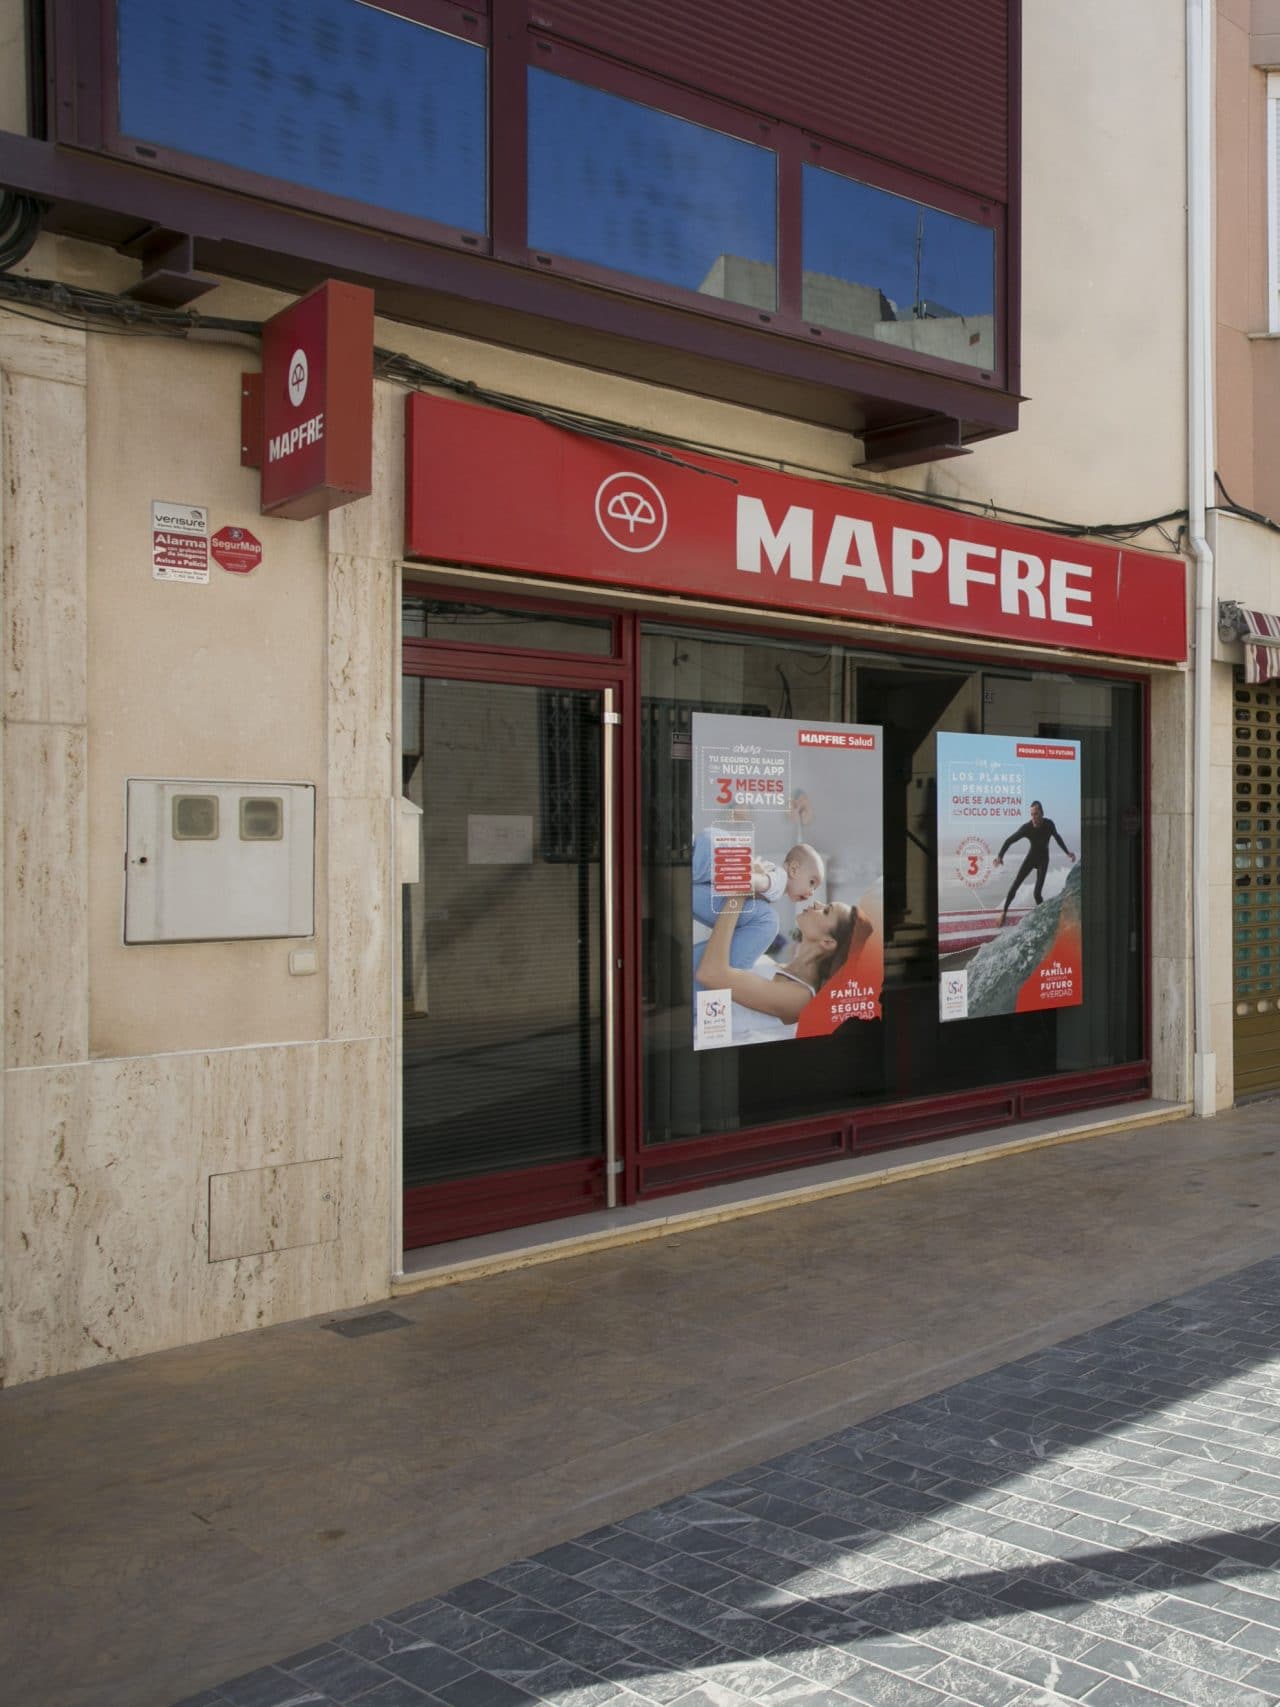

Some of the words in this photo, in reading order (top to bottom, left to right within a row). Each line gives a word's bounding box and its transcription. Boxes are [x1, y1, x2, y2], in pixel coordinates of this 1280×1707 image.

[269, 413, 323, 463] MAPFRE
[155, 515, 205, 528] verisure
[156, 534, 206, 549] Alarma
[212, 538, 262, 553] SegurMap
[736, 494, 1093, 627] MAPFRE
[801, 733, 846, 745] MAPFRE
[848, 736, 873, 747] Salud
[720, 756, 749, 764] SEGURO
[762, 758, 785, 766] SALUD
[722, 764, 761, 775] NUEVA
[764, 766, 785, 776] APP
[716, 778, 732, 804] 3
[736, 778, 784, 793] MESES
[735, 792, 785, 805] GRATIS
[952, 796, 969, 804] QUE
[972, 796, 982, 804] SE
[984, 796, 1022, 805] ADAPTAN
[963, 808, 988, 816] CICLO
[990, 808, 1000, 816] DE
[1003, 808, 1021, 816] VIDA
[1040, 967, 1072, 977] FAMILIA
[1040, 979, 1072, 990] FUTURO
[831, 987, 874, 998] FAMILIA
[831, 1001, 874, 1013] SEGURO
